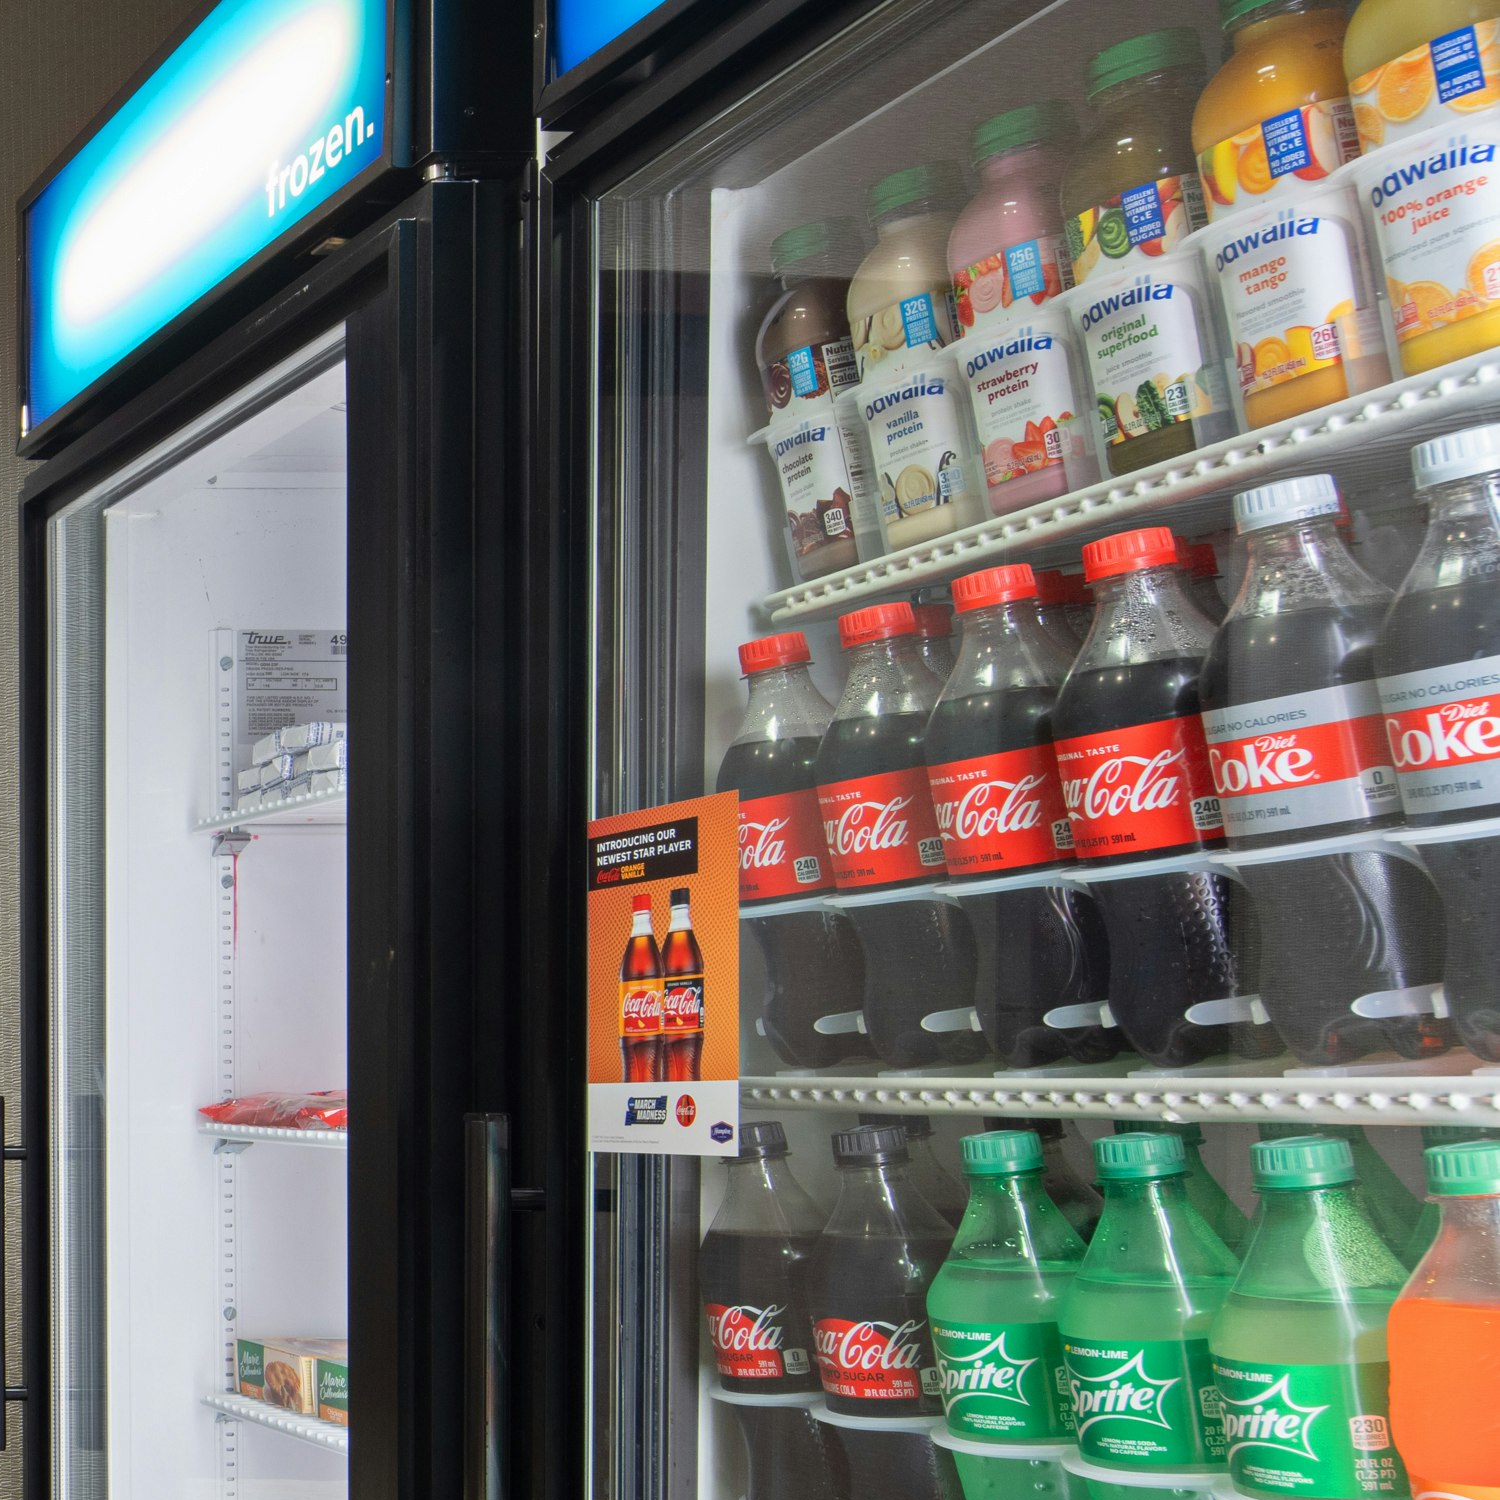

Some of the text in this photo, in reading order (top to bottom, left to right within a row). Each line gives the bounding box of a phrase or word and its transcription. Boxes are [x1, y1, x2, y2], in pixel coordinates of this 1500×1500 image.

[1440, 70, 1480, 92] NO ADDED
[1441, 78, 1481, 100] SUGAR
[1264, 115, 1298, 133] EXCELLENT
[1267, 130, 1302, 147] VITAMINS
[266, 105, 374, 218] frozen.
[1280, 150, 1305, 165] ADDED
[1272, 158, 1307, 176] SUGAR
[1380, 173, 1488, 227] 100% orange
[1126, 202, 1158, 217] VITAMINS
[1138, 221, 1161, 235] ADDED
[1411, 205, 1450, 235] juice
[1131, 228, 1161, 244] SUGAR
[1010, 247, 1034, 266] 25G
[1012, 260, 1036, 274] PROTEIN
[1239, 256, 1287, 283] mango
[1245, 271, 1288, 297] tango
[1267, 288, 1305, 307] smoothie
[904, 298, 927, 316] 32G
[1101, 314, 1146, 343] original
[1097, 324, 1159, 360] superfood
[790, 351, 808, 368] 32G
[1121, 350, 1153, 368] smoothie
[977, 361, 1039, 393] strawberry
[988, 378, 1029, 405] protein
[886, 410, 919, 430] vanilla
[887, 421, 923, 445] protein
[782, 452, 814, 475] chocolate
[787, 465, 812, 486] protein
[825, 509, 842, 524] 340
[1429, 673, 1500, 696] CALORIES
[1244, 709, 1307, 729] CALORIES
[1440, 701, 1490, 723] Diet
[1255, 734, 1297, 753] Diet
[1386, 713, 1500, 767] Coke
[1085, 744, 1120, 757] TASTE
[956, 769, 988, 782] TASTE
[1209, 744, 1317, 794] Coke
[836, 790, 861, 802] TASTE
[936, 773, 1047, 841] ca-Cola
[1193, 798, 1220, 815] 240
[596, 828, 676, 853] INTRODUCING OUR
[919, 838, 943, 853] 240
[596, 839, 692, 867] NEWEST STAR PLAYER
[621, 862, 645, 873] ORANGE
[796, 857, 817, 871] 240
[596, 867, 620, 884] Coca-Cola
[621, 870, 645, 880] VANILLA
[622, 990, 662, 1018] Coca-Cola
[634, 1099, 656, 1110] MARCH
[636, 1110, 666, 1121] MADNESS
[938, 1328, 992, 1341] LEMON-LIME
[1070, 1345, 1129, 1360] LEMON-LIME
[320, 1372, 346, 1388] Marie
[843, 1372, 885, 1382] SUGAR
[938, 1358, 1015, 1394] Sprite
[1217, 1365, 1273, 1384] LEMON-LIME
[840, 1384, 856, 1397] COLA
[1071, 1379, 1155, 1418] Sprite
[1219, 1401, 1301, 1441] Sprite
[1353, 1419, 1384, 1434] 230
[1355, 1457, 1394, 1469] 20 OZ
[1355, 1468, 1397, 1481] (1.25 PT)
[1362, 1481, 1378, 1492] 591
